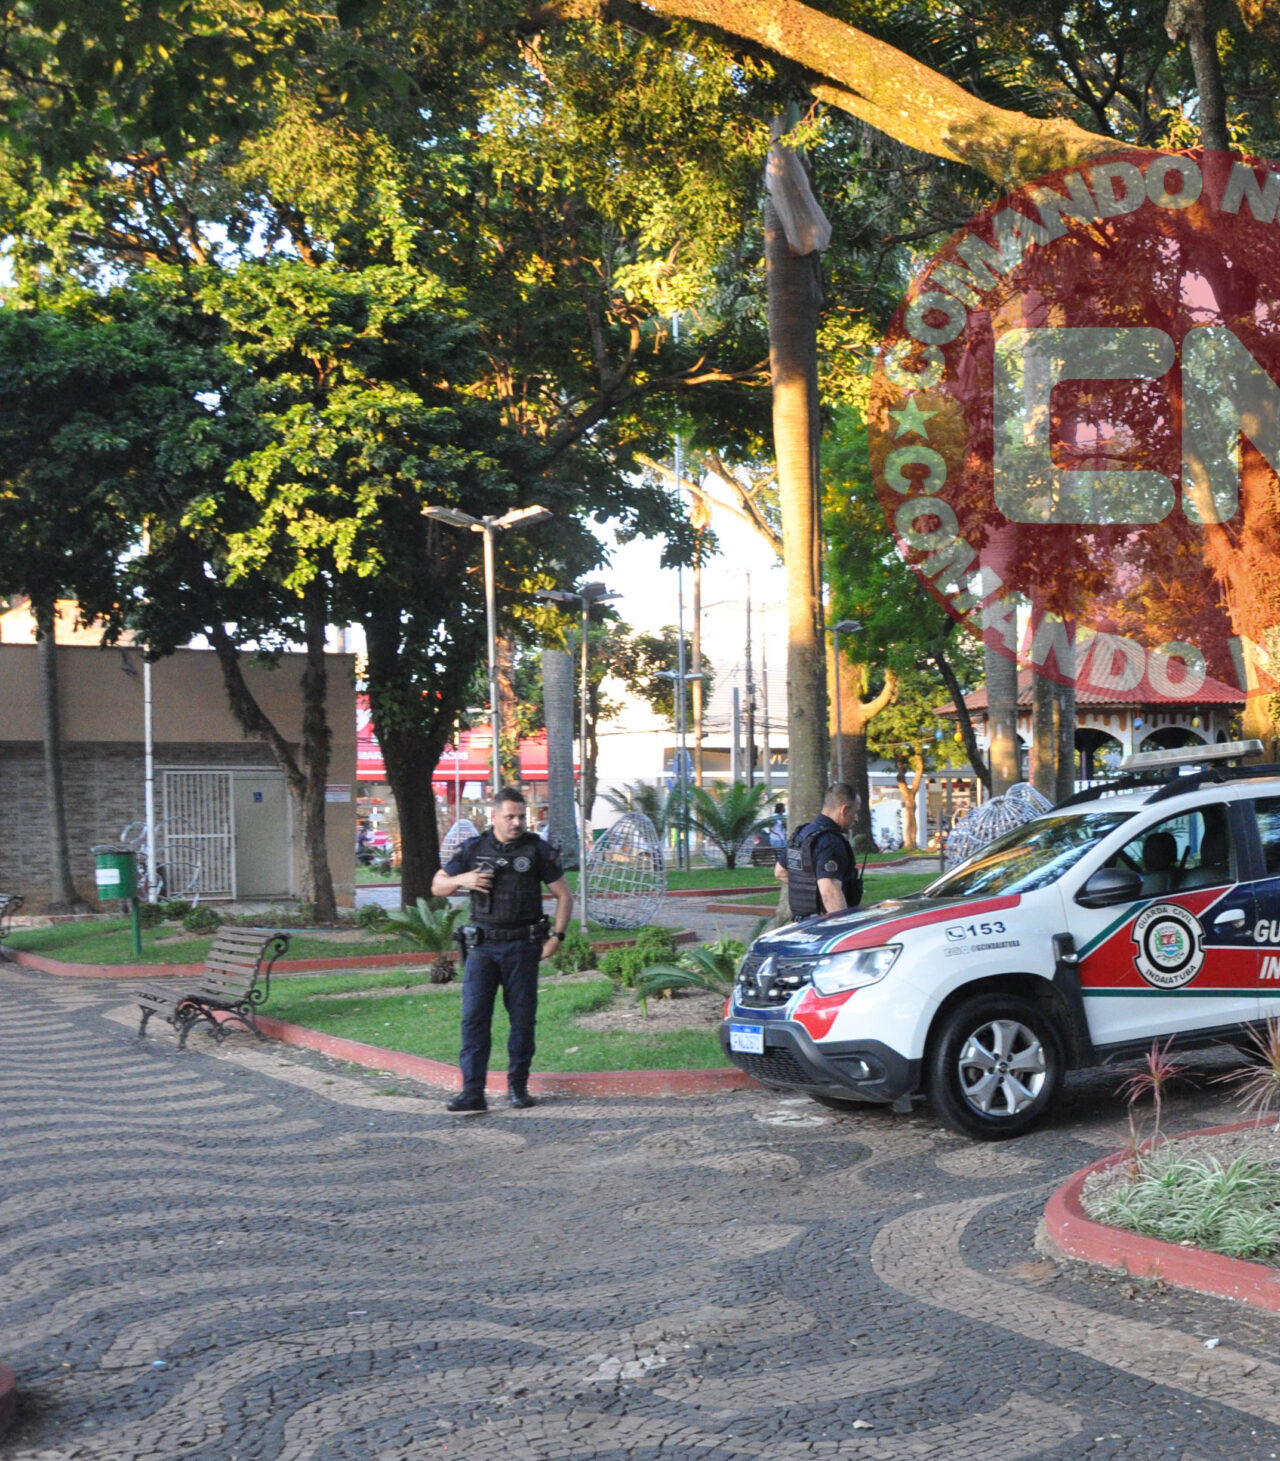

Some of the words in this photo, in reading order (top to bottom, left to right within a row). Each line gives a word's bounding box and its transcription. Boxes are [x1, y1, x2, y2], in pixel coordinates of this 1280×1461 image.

[967, 921, 1007, 936] 153
[1138, 907, 1169, 930] GUARDA
[1172, 908, 1193, 925] CIVIL
[1145, 964, 1197, 984] INDAIATUBA
